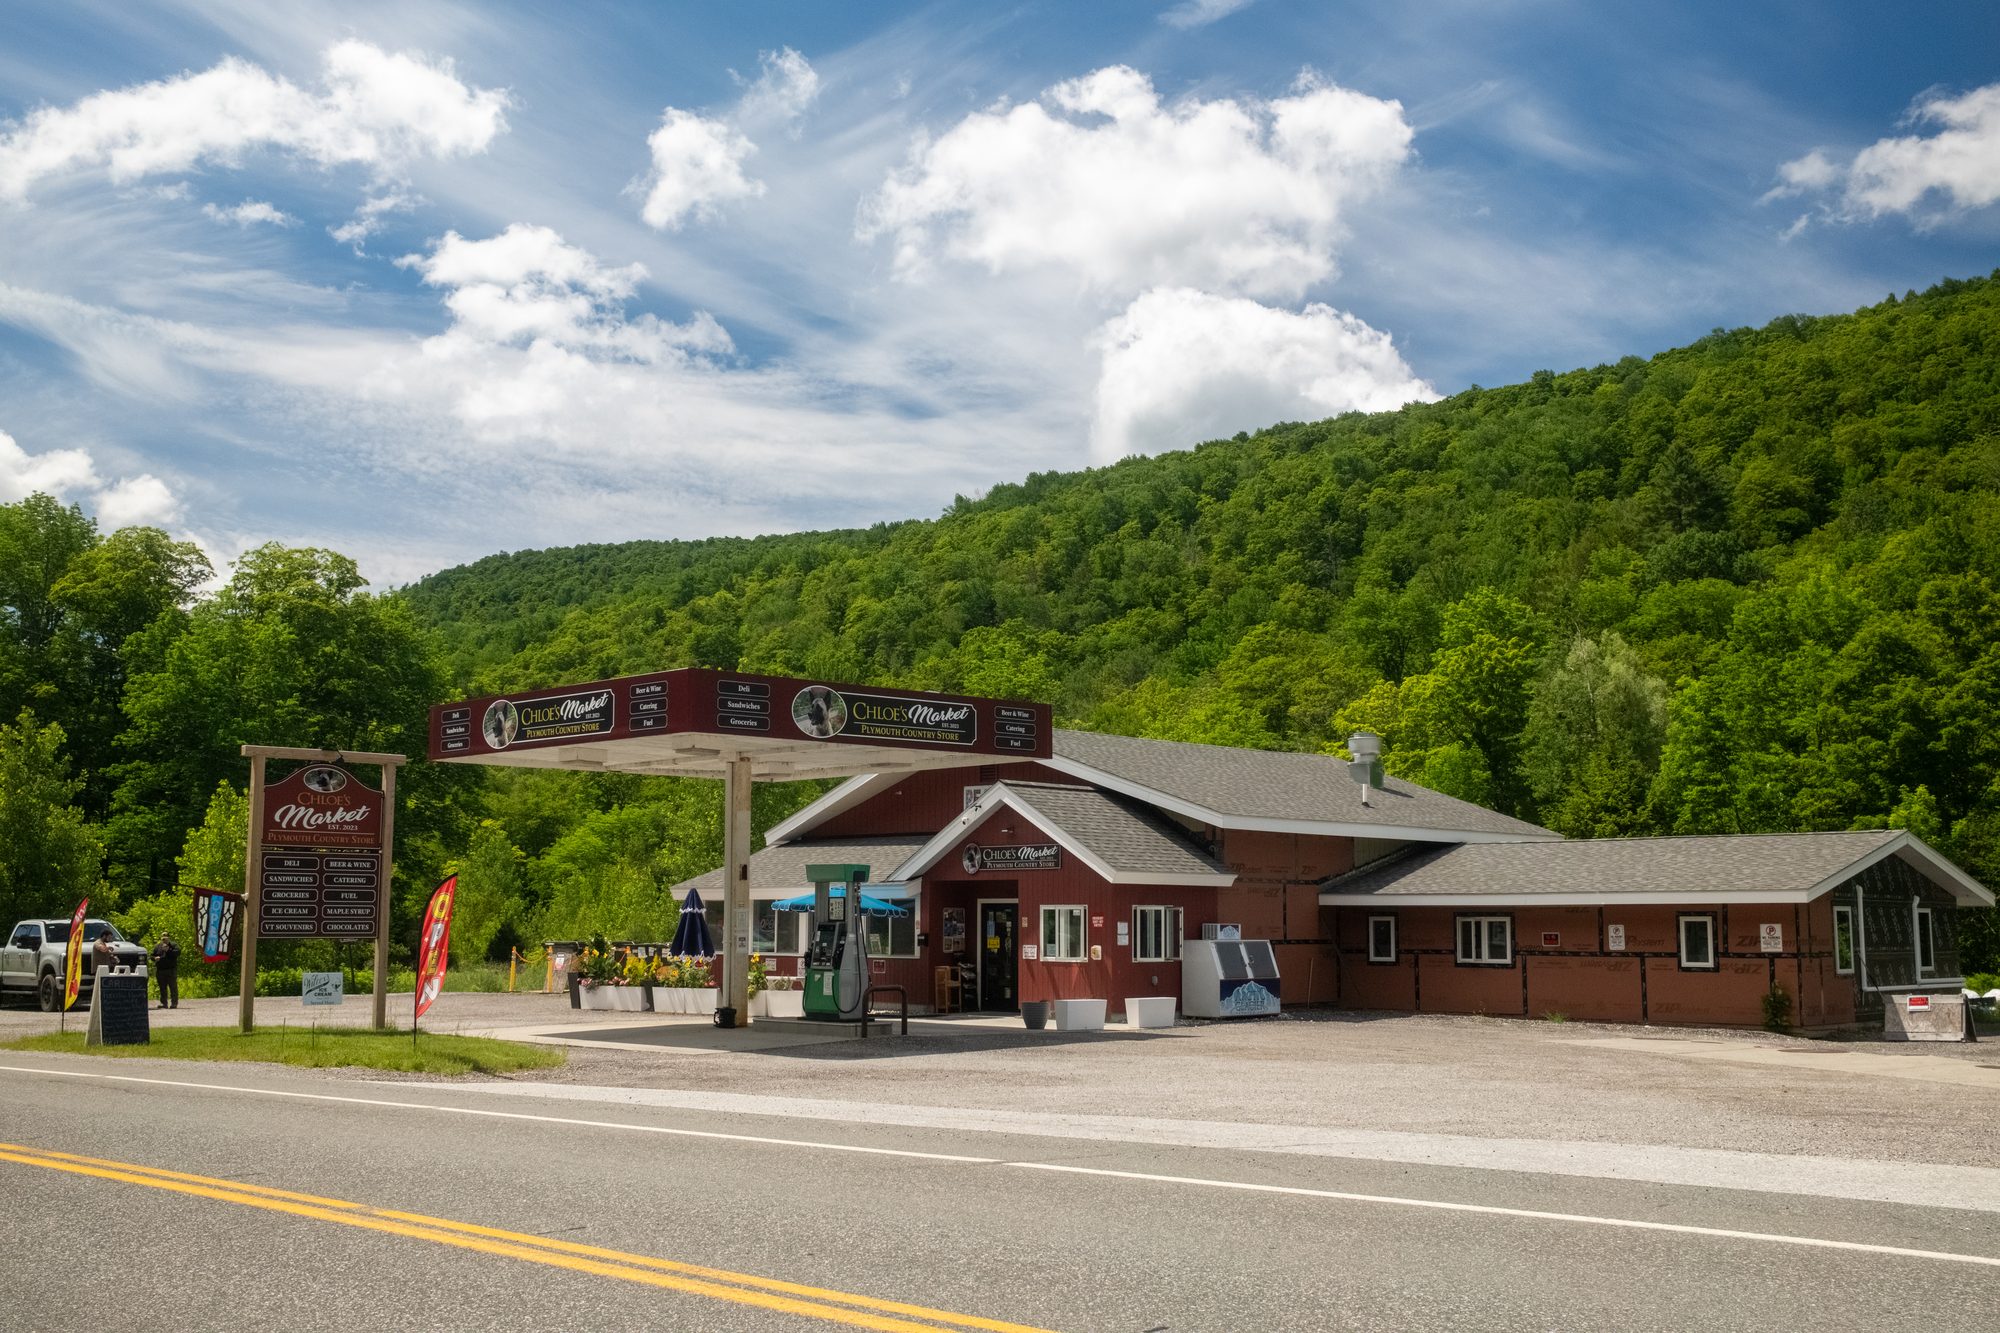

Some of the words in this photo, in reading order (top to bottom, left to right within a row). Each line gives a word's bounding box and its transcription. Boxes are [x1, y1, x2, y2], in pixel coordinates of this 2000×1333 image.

[521, 705, 561, 726] CHLOE'S
[560, 693, 609, 721] Market
[639, 702, 658, 711] Catering
[727, 701, 761, 710] Sandwiches
[853, 702, 908, 722] CHLOE'S
[908, 704, 969, 725] Market
[643, 719, 653, 727] Fuel
[730, 718, 758, 727] Groceries
[1005, 724, 1026, 733] Catering
[526, 728, 555, 738] PLYMOUTH
[555, 725, 581, 736] COUNTRY
[582, 723, 600, 733] STORE
[861, 724, 901, 737] PLYMOUTH
[901, 727, 936, 739] COUNTRY
[936, 730, 960, 741] STORE
[297, 792, 351, 806] CHLOE'S
[274, 804, 371, 829] Market
[268, 833, 311, 842] PLYMOUTH
[313, 834, 350, 843] COUNTRY
[352, 836, 375, 844] STORE
[1018, 846, 1058, 860] Market
[207, 901, 221, 951] OPEN
[419, 893, 450, 1006] OPEN
